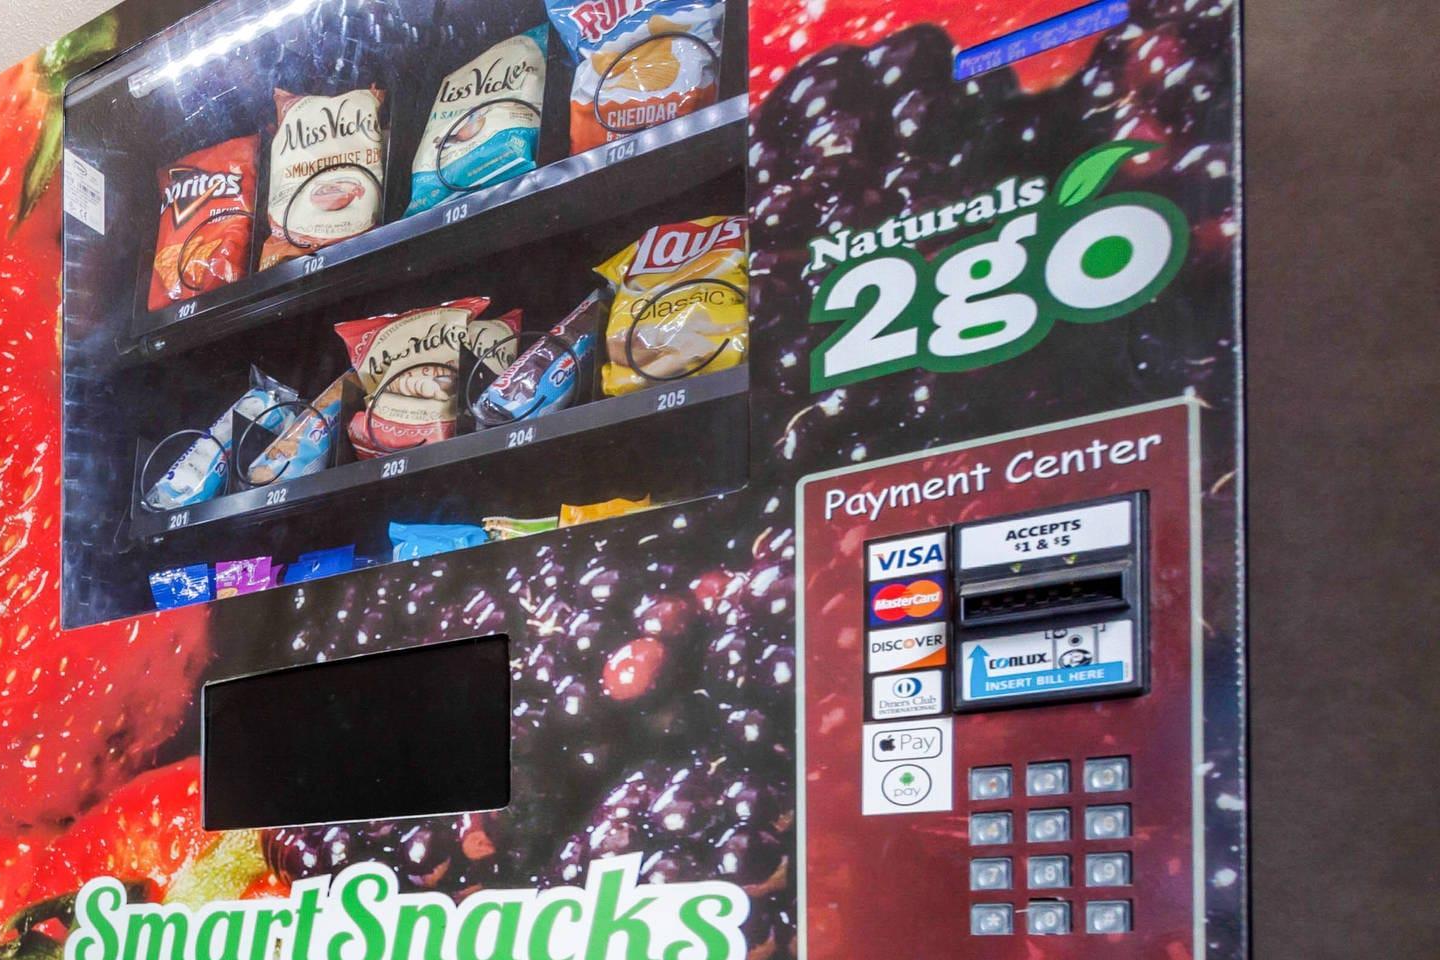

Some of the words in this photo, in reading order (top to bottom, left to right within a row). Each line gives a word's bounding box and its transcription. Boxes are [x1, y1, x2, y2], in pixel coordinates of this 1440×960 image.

[607, 102, 677, 128] CHEDDAR
[280, 118, 328, 156] Miss
[610, 142, 635, 163] 104
[284, 151, 361, 179] SMOKEHOUSE
[445, 204, 468, 221] 103
[810, 177, 1047, 270] Naturals
[304, 256, 325, 274] 102
[822, 203, 1174, 378] 2go
[178, 302, 197, 319] 101
[630, 288, 725, 321] Classic
[657, 389, 686, 411] 205
[508, 427, 535, 448] 204
[382, 458, 406, 478] 203
[824, 463, 992, 521] Payment
[1005, 434, 1162, 484] Center
[266, 488, 287, 506] 202
[169, 512, 188, 529] 201
[1005, 519, 1081, 542] ACCEPTS
[1015, 540, 1030, 553] $1
[1036, 538, 1049, 551] &
[1054, 534, 1071, 547] $5
[872, 543, 944, 572] VISA
[874, 591, 942, 611] MasterCard
[871, 634, 943, 654] DISCOVER
[985, 677, 1032, 692] INSERT
[1036, 673, 1064, 686] BILL
[1069, 669, 1105, 681] HERE
[879, 698, 910, 709] Diners
[912, 694, 937, 706] Club
[900, 733, 936, 754] Pay
[1045, 773, 1056, 789] 2
[894, 786, 921, 799] pay
[988, 867, 1000, 883] 7
[1044, 865, 1057, 882] 8
[1103, 862, 1116, 880] 9
